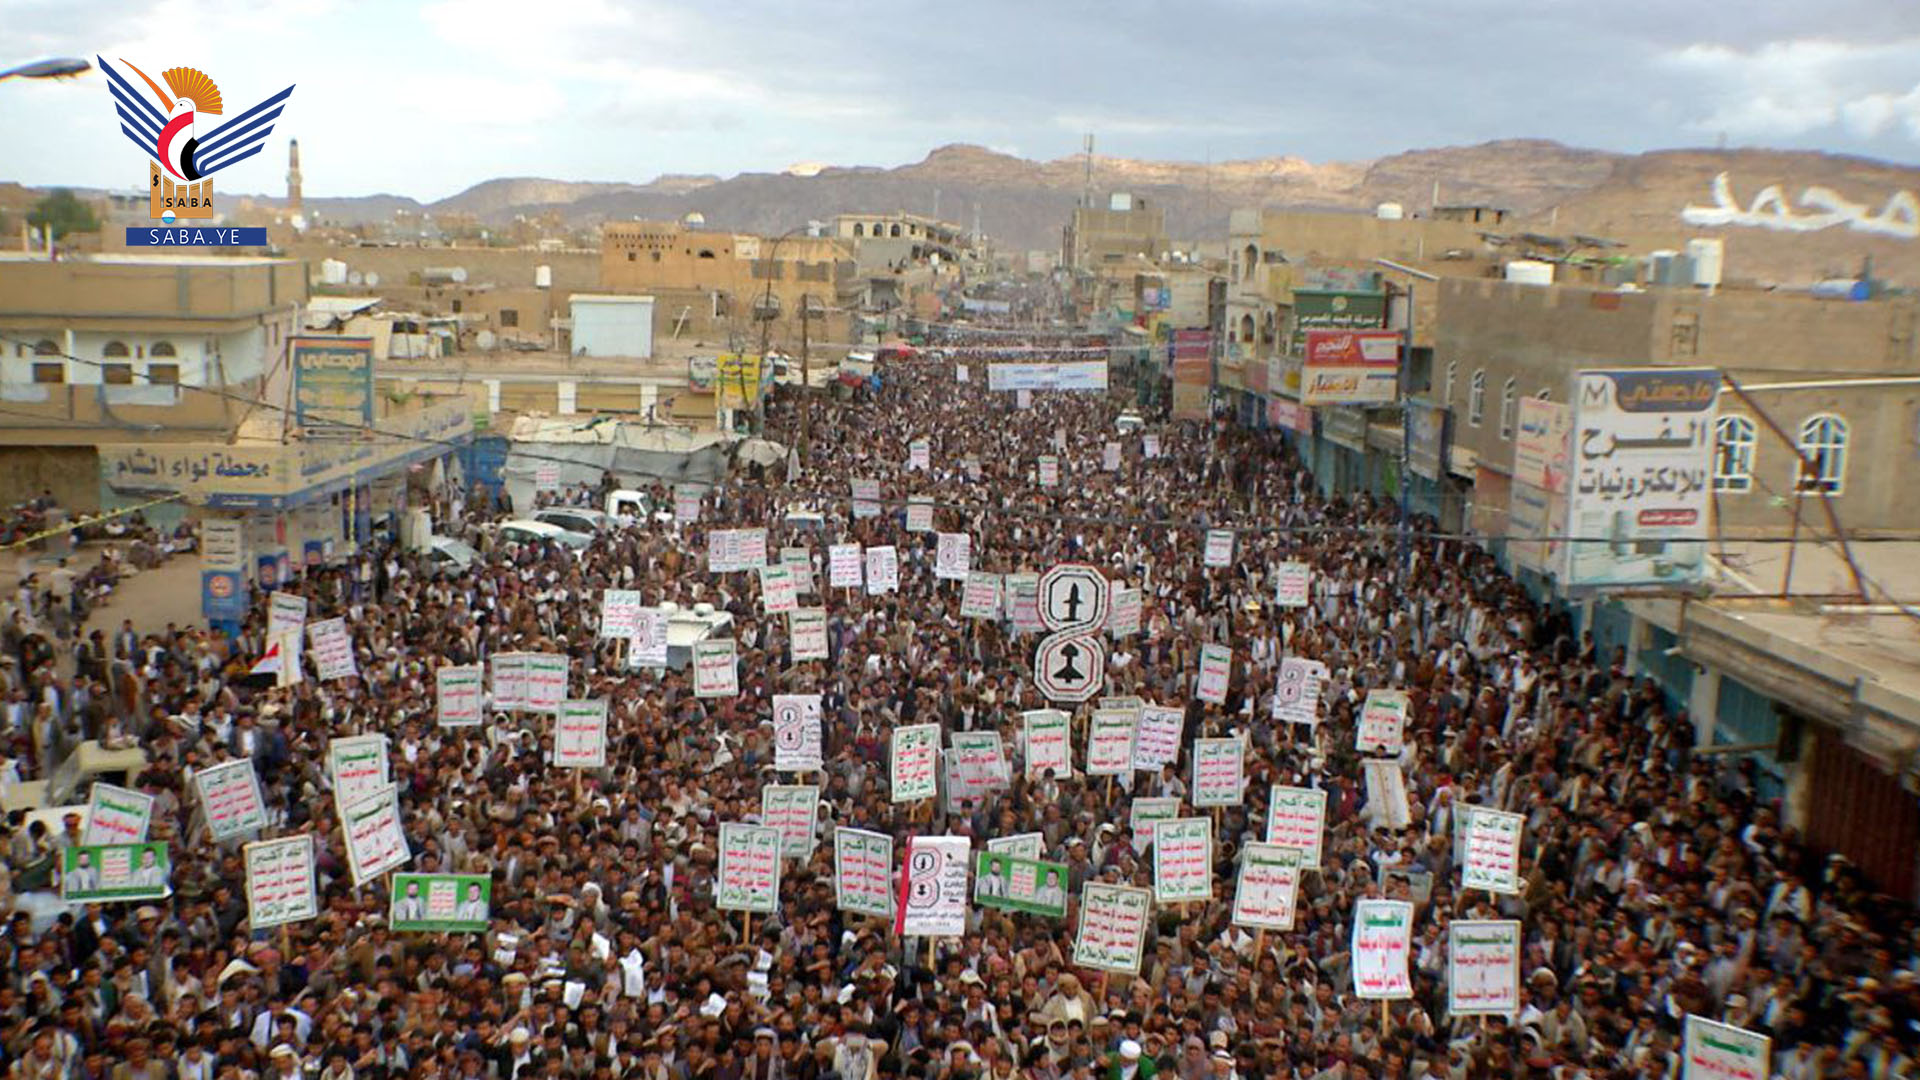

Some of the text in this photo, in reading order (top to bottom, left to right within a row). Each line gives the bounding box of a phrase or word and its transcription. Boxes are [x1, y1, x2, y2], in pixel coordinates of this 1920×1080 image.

[1680, 171, 1920, 238] محمد
[1581, 417, 1708, 459] الفرح
[116, 448, 166, 478] الشام
[171, 456, 210, 483] لواء
[213, 452, 270, 478] محطة
[1578, 465, 1706, 501] للإلكترونيات
